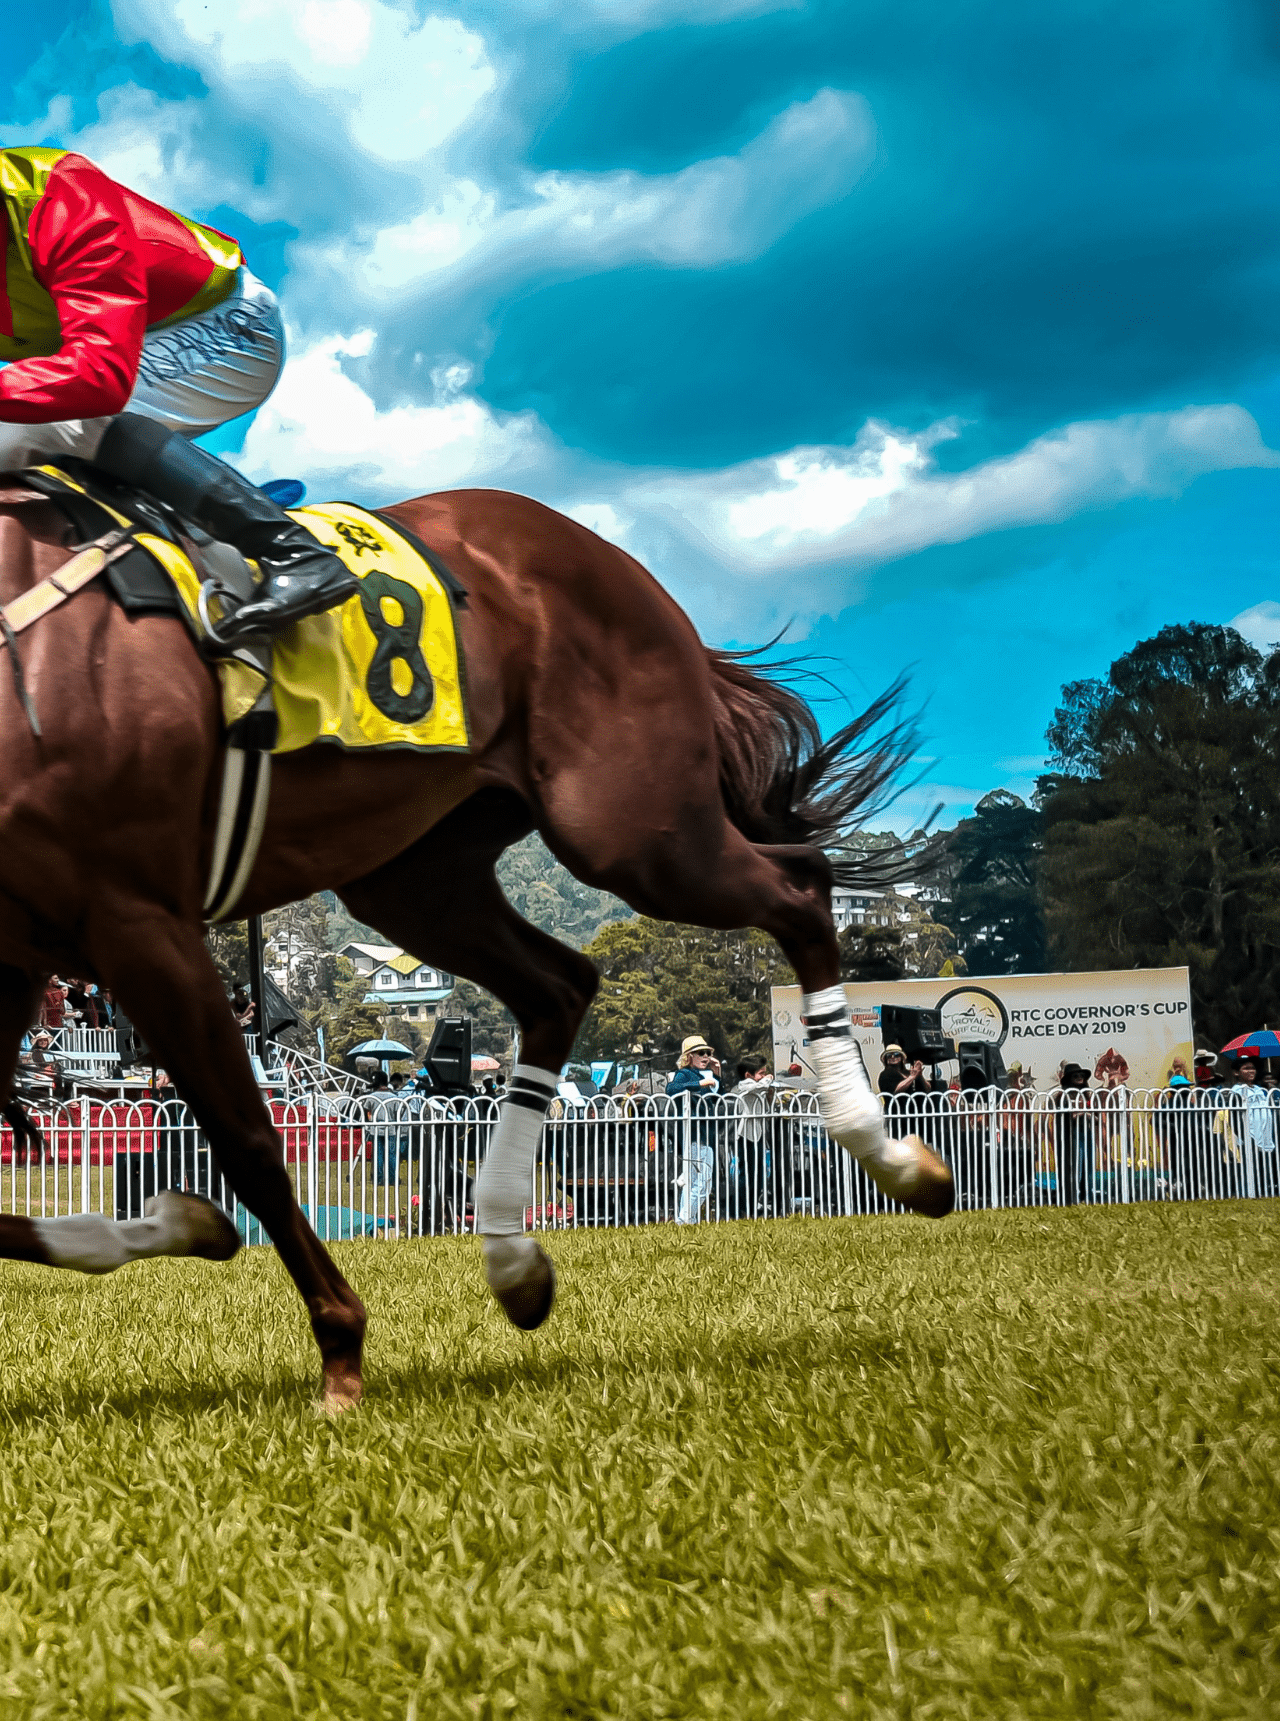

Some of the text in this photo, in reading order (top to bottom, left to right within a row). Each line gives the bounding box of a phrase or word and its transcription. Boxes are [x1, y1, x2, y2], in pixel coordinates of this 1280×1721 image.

[359, 569, 434, 724] 8
[1011, 1001, 1188, 1022] RTC GOVERNOR'S CUP
[955, 1017, 985, 1026] ROYAL
[1011, 1021, 1126, 1038] RACE DAY 2019
[969, 1025, 996, 1038] CLUB
